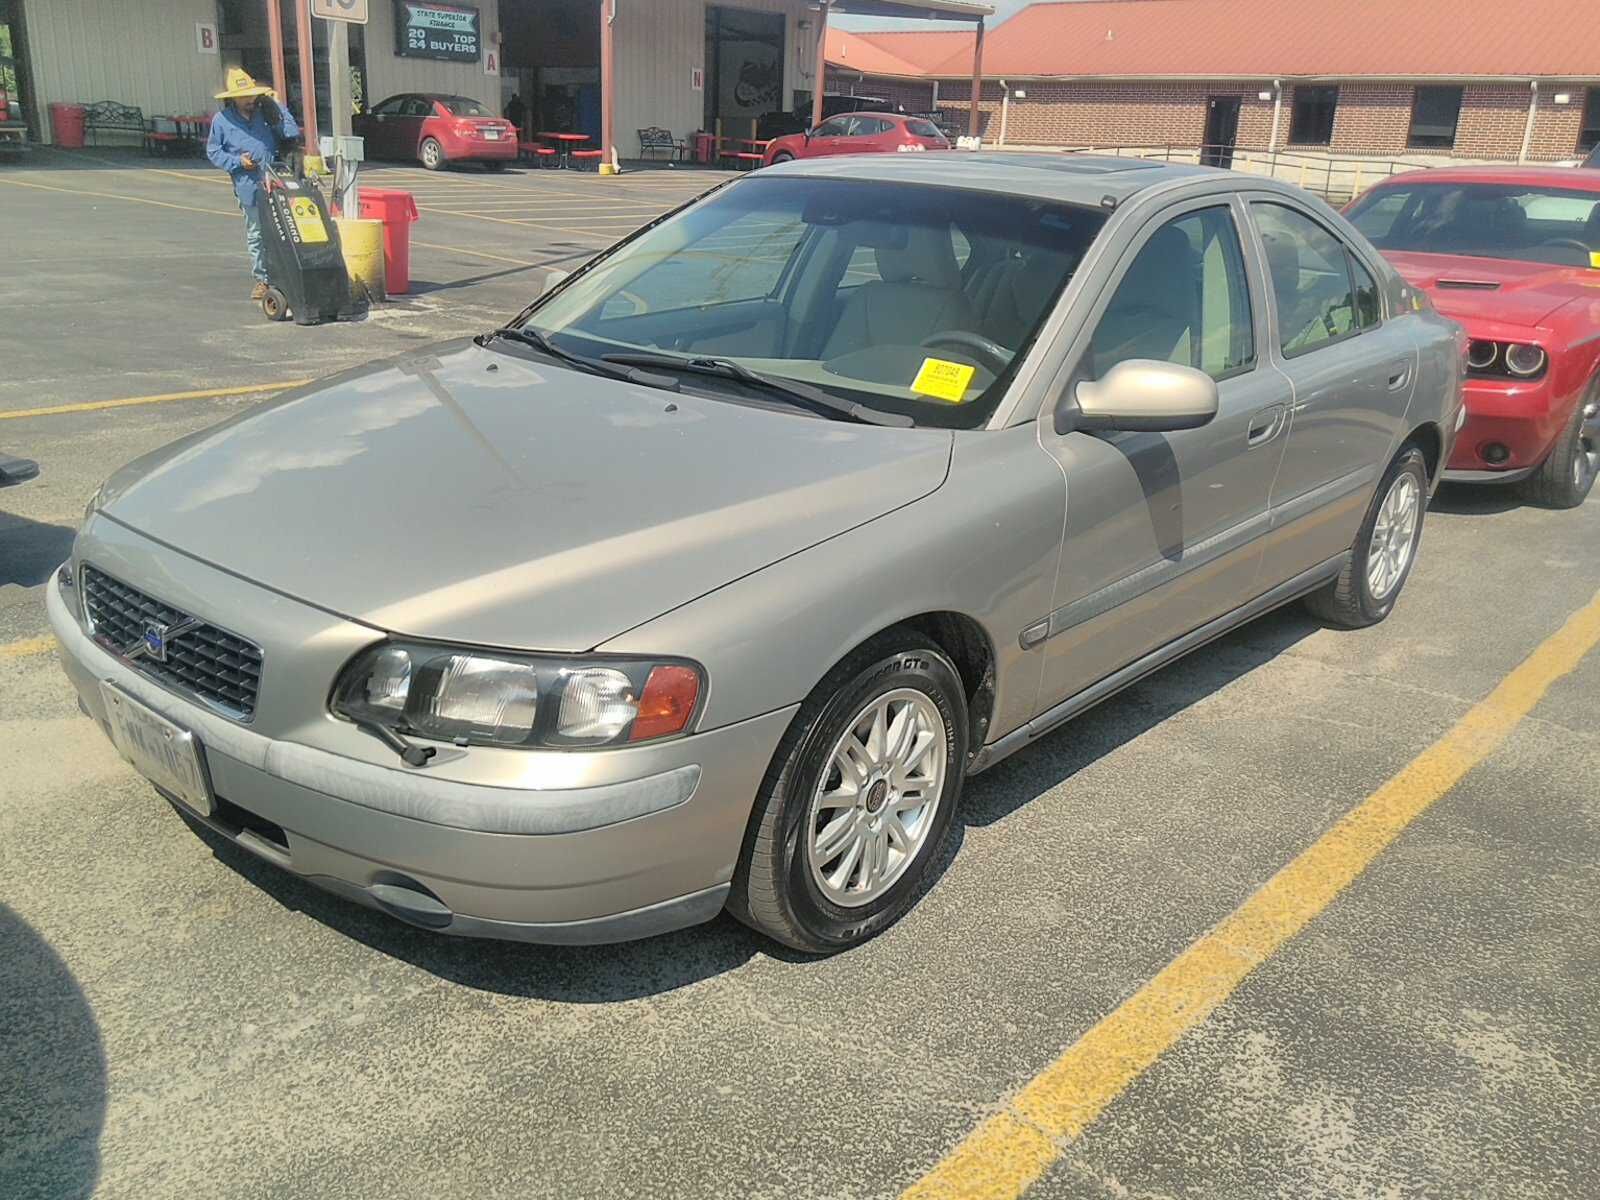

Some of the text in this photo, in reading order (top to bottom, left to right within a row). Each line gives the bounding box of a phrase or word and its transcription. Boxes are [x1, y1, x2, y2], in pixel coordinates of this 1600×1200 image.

[416, 10, 467, 22] STATE SUPERIOR
[201, 28, 213, 48] B
[408, 28, 426, 39] 20
[453, 34, 476, 44] TOP
[408, 39, 426, 49] 24
[430, 41, 477, 53] BUYERS
[487, 53, 496, 71] A
